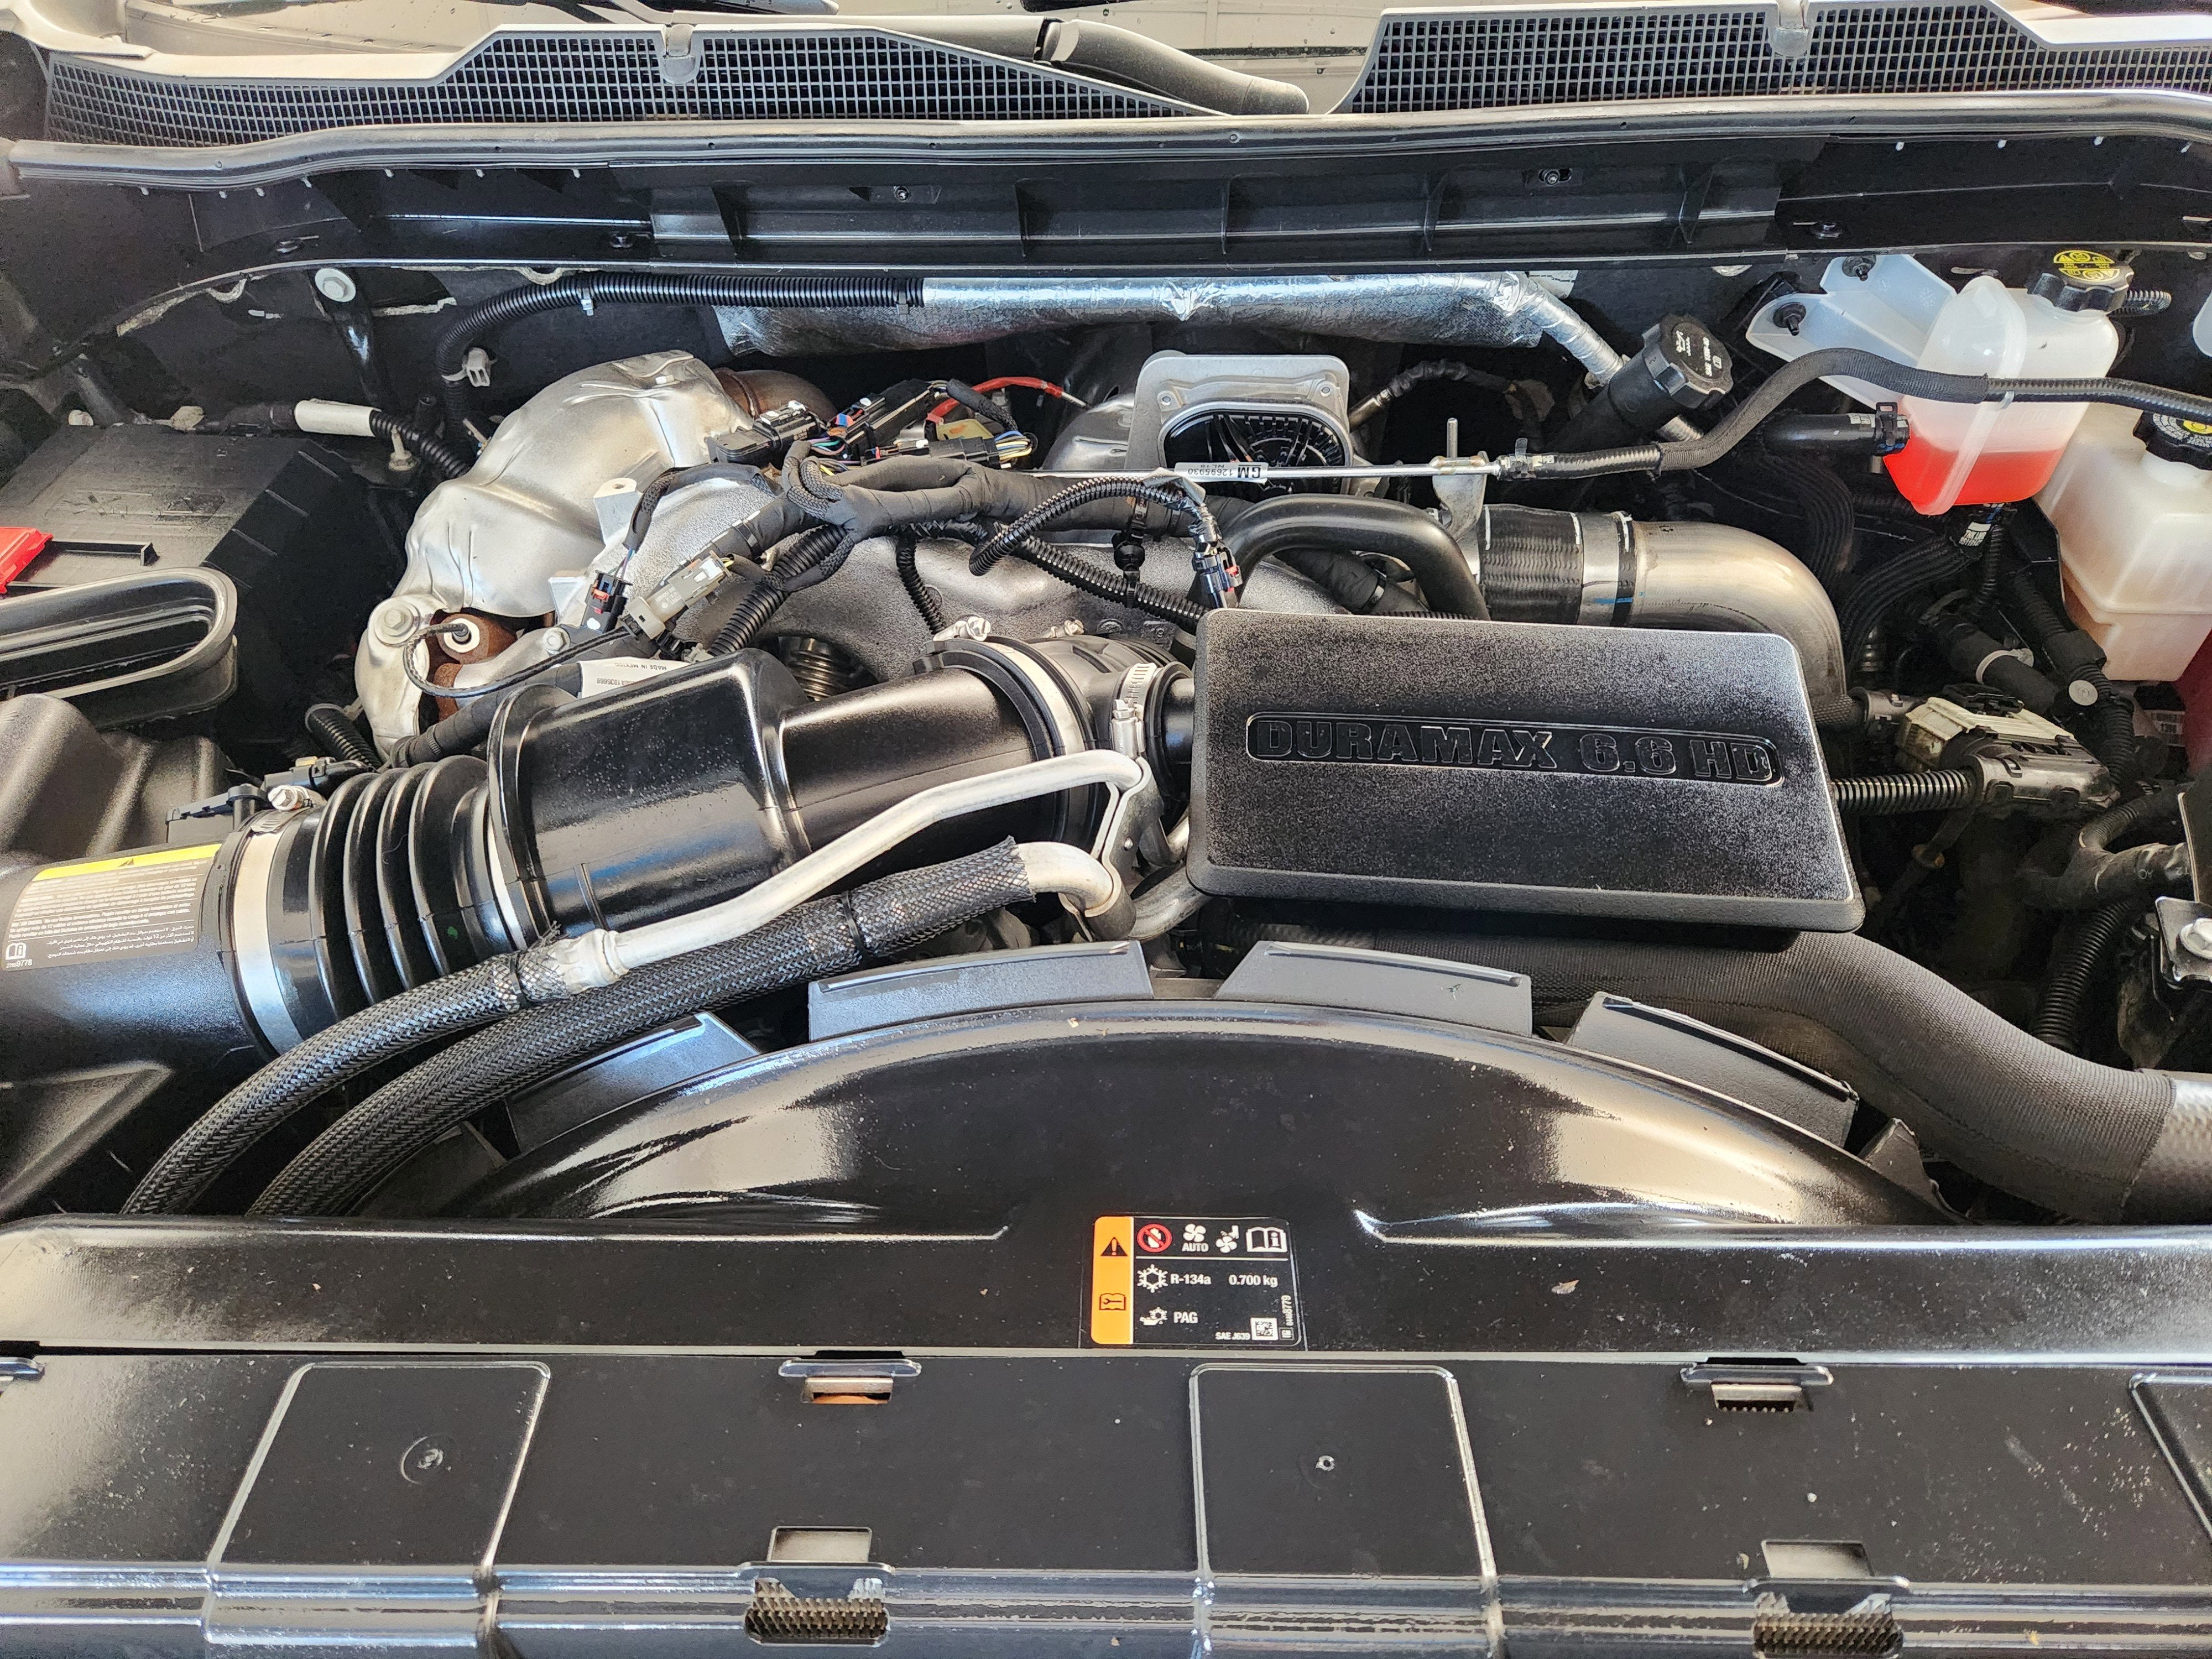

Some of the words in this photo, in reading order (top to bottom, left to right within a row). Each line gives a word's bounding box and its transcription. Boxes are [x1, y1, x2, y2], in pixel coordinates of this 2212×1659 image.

[1188, 468, 1233, 477] 12695930
[1237, 467, 1261, 479] GM
[1254, 719, 1558, 769] DURAMAX
[1578, 731, 1678, 776] 6.6
[1690, 739, 1777, 781] HD
[1182, 1242, 1209, 1253] AUTO
[1170, 1273, 1212, 1286] R-134a
[1228, 1274, 1261, 1286] 0.700
[1262, 1275, 1279, 1288] kg
[1173, 1312, 1198, 1324] PAG
[1215, 1332, 1232, 1340] SAE
